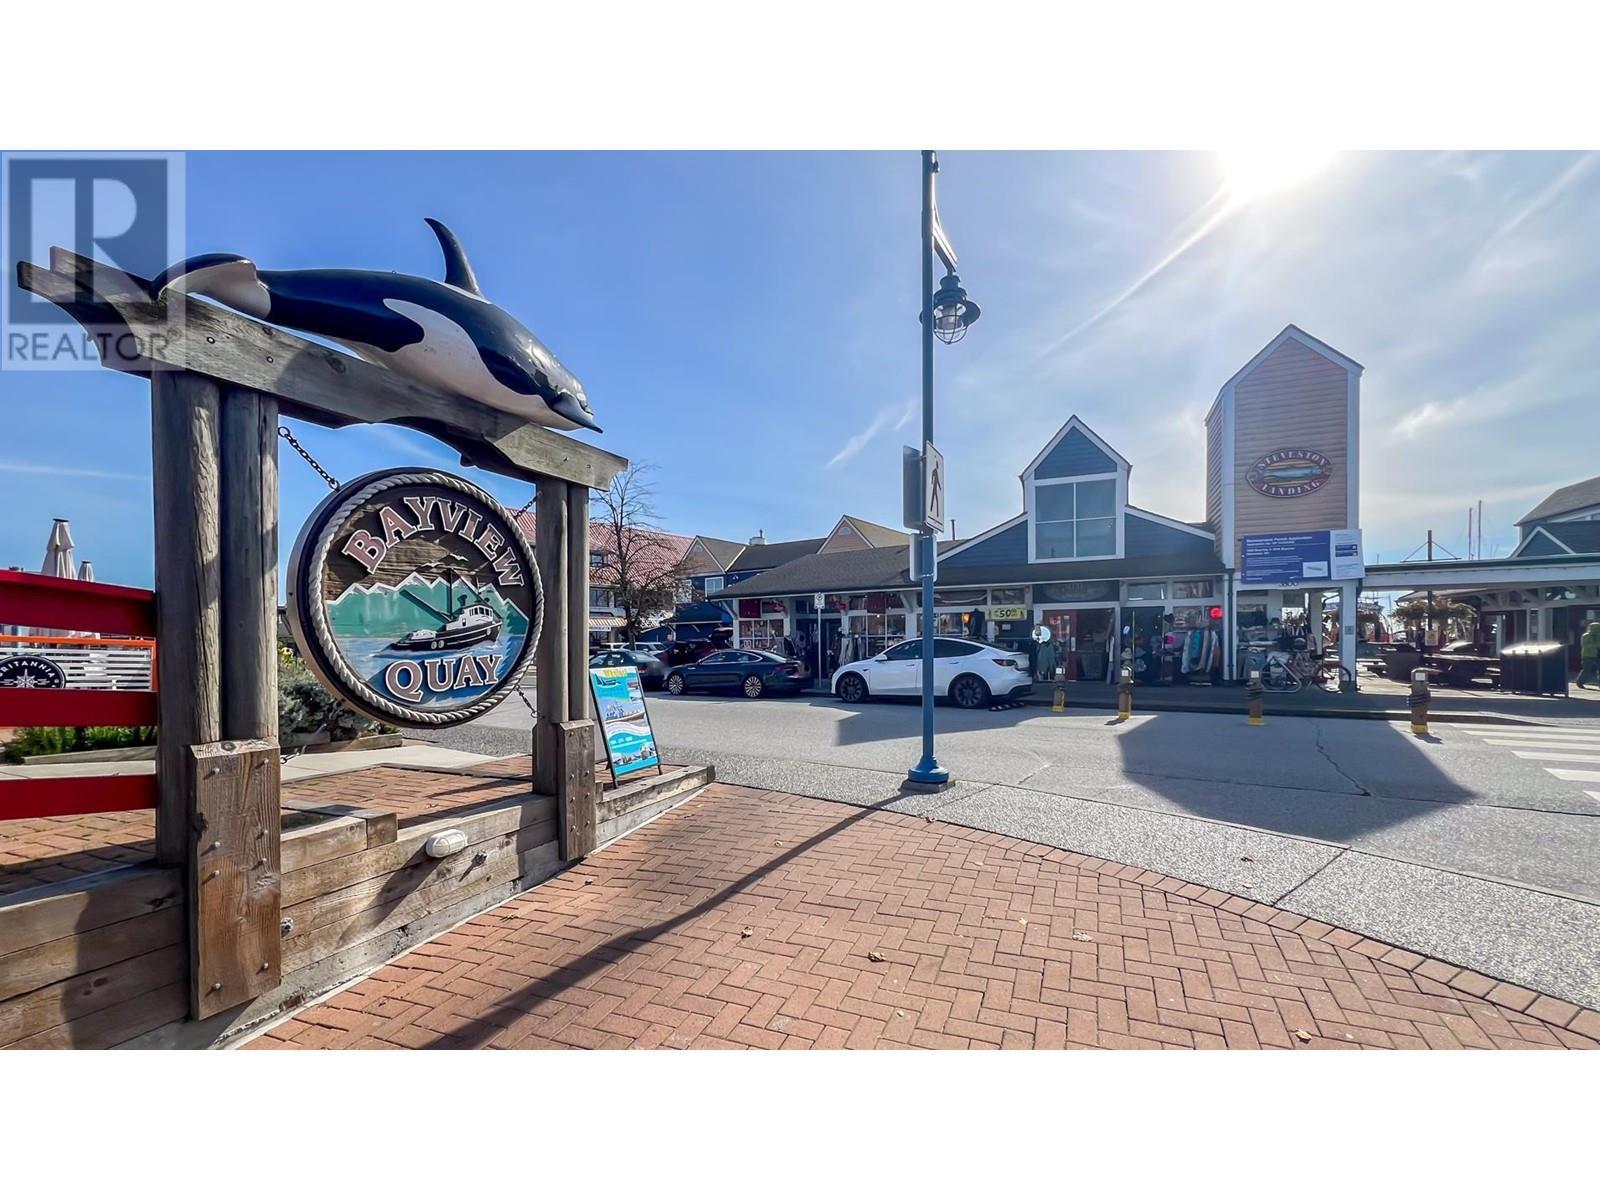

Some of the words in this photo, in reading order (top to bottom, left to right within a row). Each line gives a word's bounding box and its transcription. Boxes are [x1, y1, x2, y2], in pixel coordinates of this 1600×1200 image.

[1262, 480, 1321, 496] LANDING
[341, 496, 524, 587] BAYVIEW
[385, 654, 503, 702] QUAY
